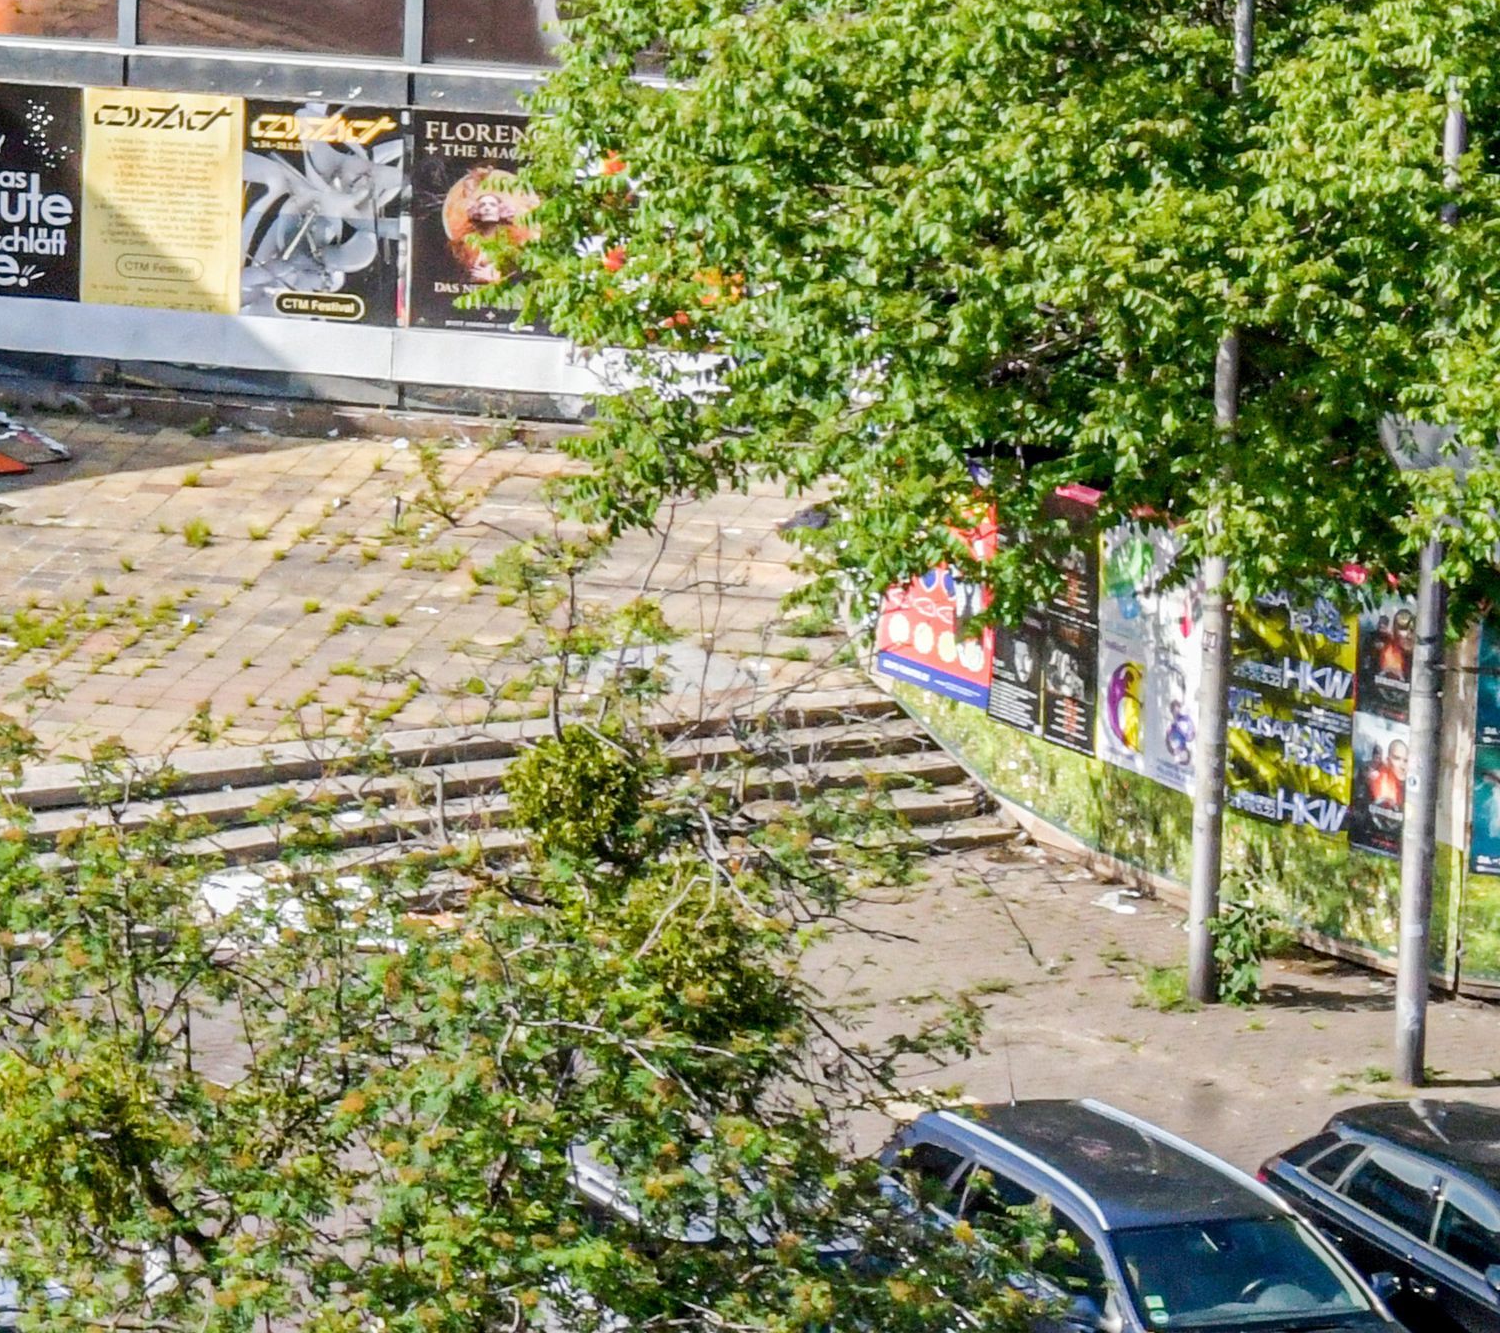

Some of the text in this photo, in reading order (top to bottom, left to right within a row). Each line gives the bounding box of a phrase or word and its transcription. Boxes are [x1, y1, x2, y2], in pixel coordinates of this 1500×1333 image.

[444, 144, 477, 158] THE
[124, 261, 194, 275] CTM Festival
[434, 282, 459, 294] DAS
[282, 298, 355, 314] CTM Festival
[1283, 657, 1352, 700] HKW
[1277, 787, 1349, 833] HKW
